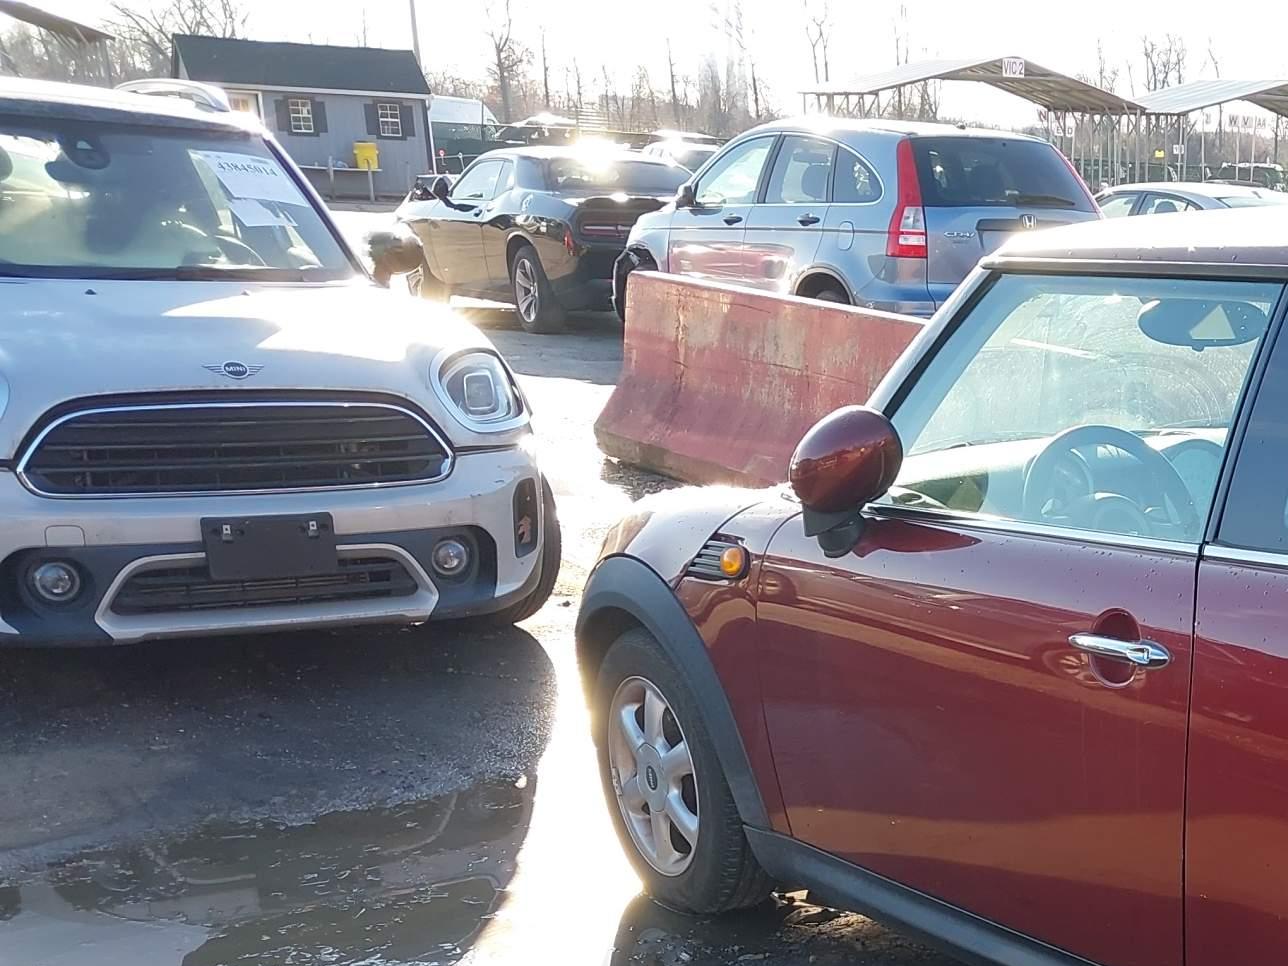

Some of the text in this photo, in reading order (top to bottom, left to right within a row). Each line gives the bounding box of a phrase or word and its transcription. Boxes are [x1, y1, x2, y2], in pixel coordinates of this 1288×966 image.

[1004, 60, 1024, 75] VIC 2
[1229, 115, 1238, 126] W
